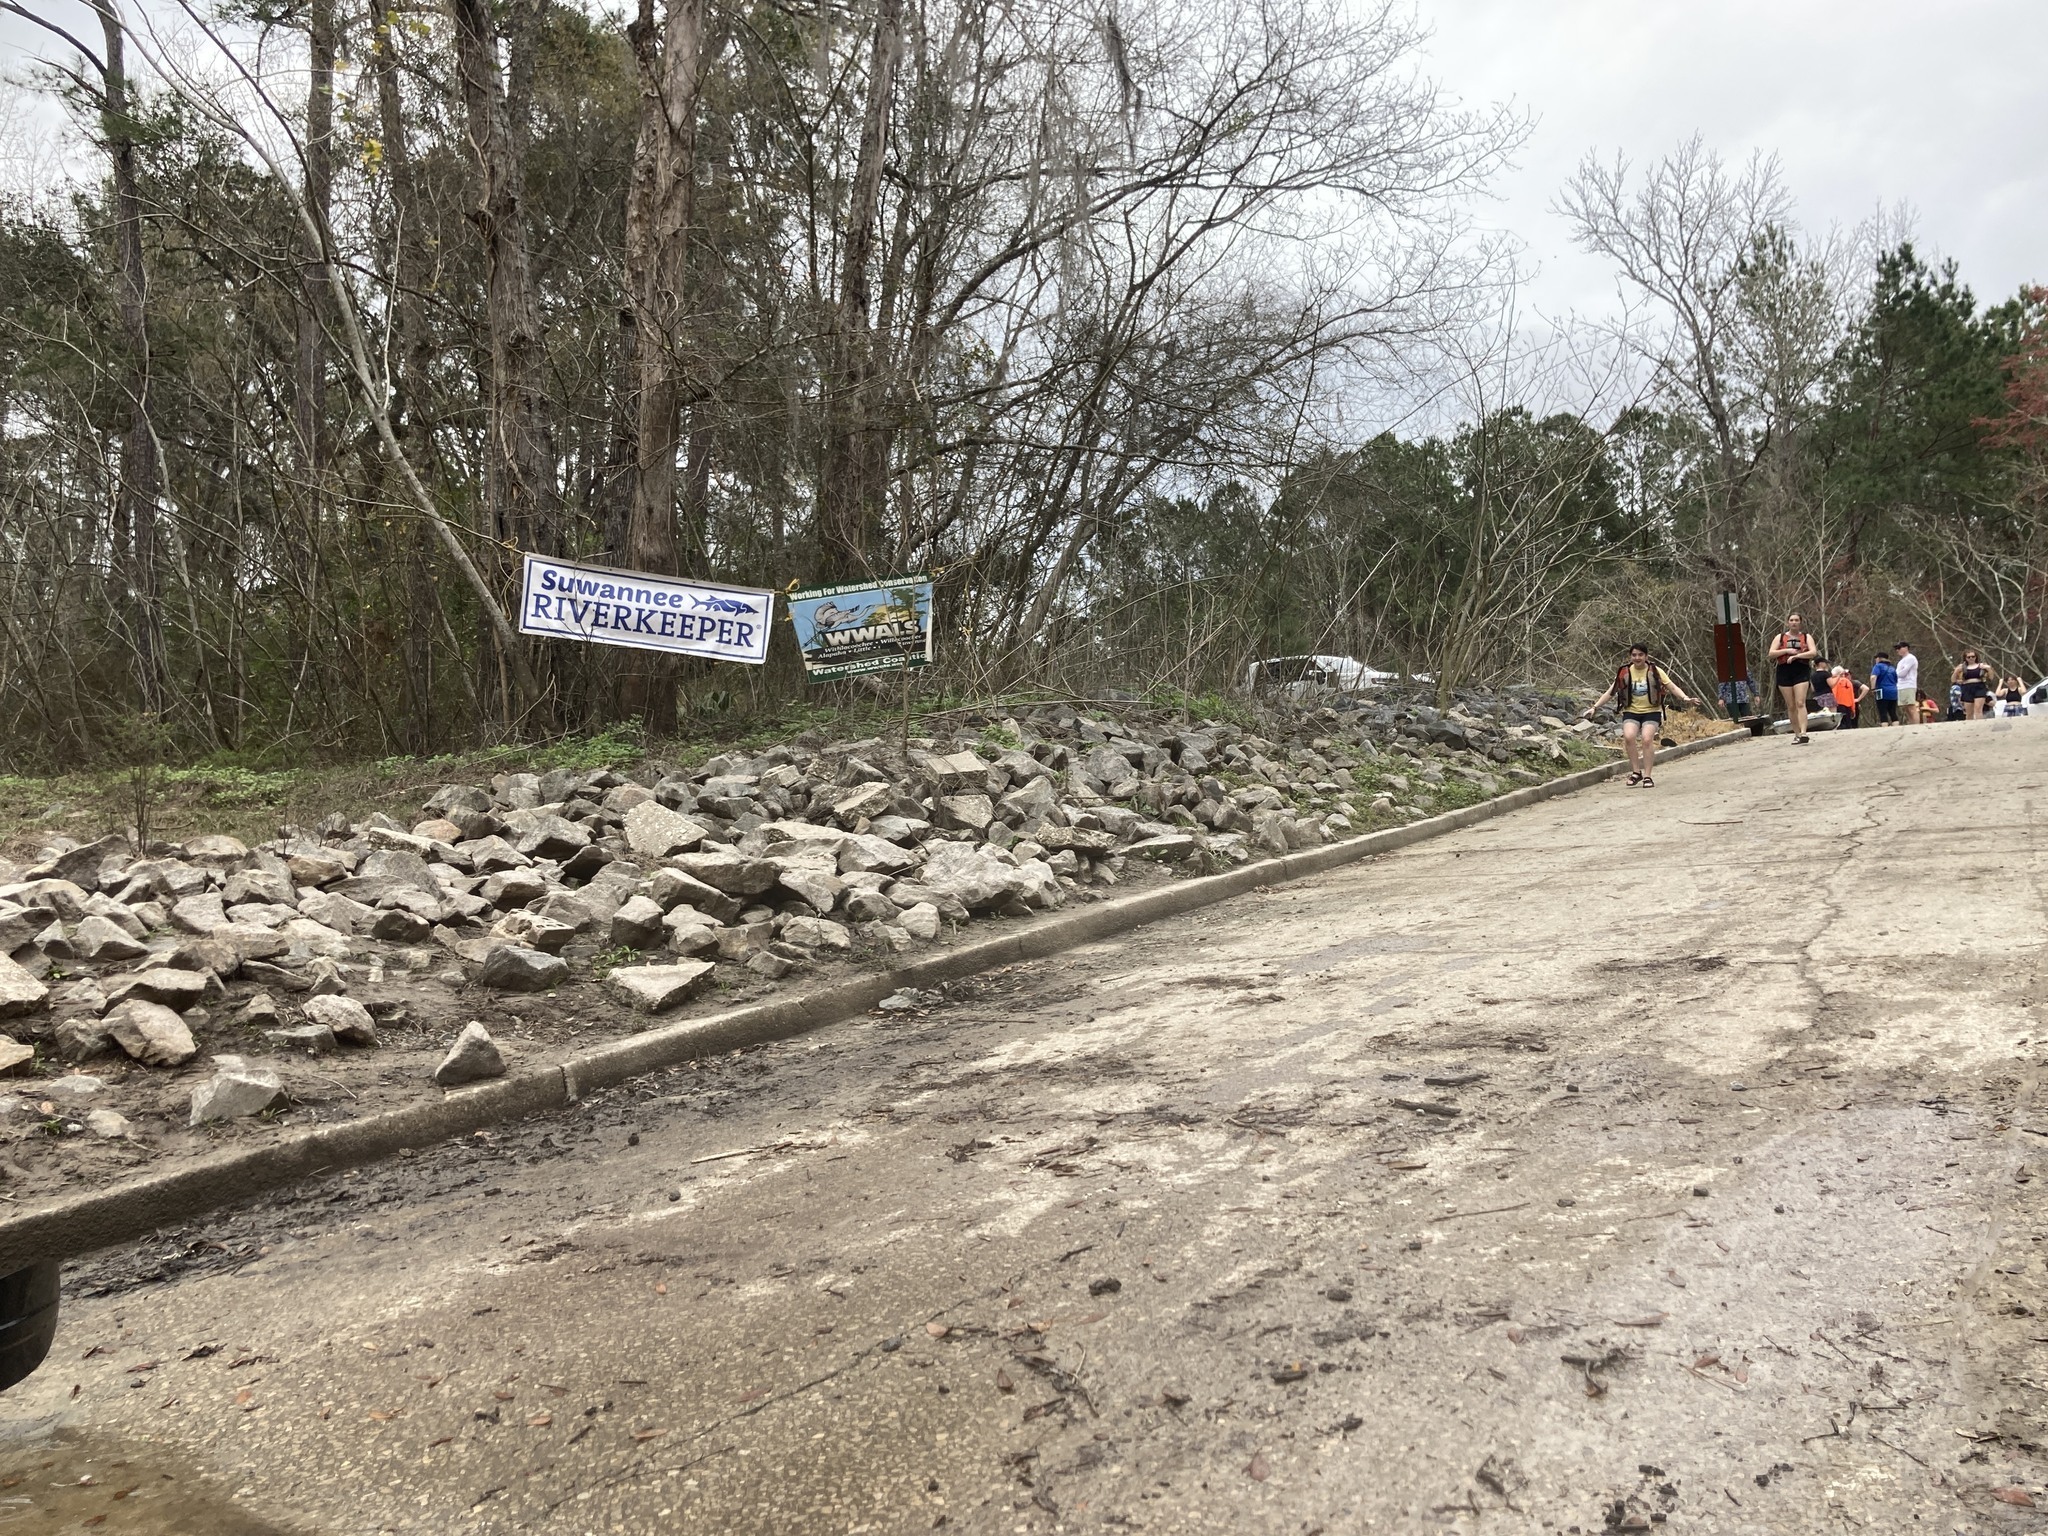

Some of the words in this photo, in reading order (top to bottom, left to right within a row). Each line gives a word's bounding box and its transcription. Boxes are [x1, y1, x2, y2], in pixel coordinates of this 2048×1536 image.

[541, 569, 684, 609] Suwannee
[788, 589, 823, 602] Working
[823, 587, 836, 597] For
[836, 580, 878, 595] Watershed
[530, 592, 754, 648] RIVERKEEPER
[825, 619, 920, 647] WWALS
[817, 650, 847, 660] Alapaha
[853, 646, 871, 654] Little
[812, 659, 879, 676] Watershed
